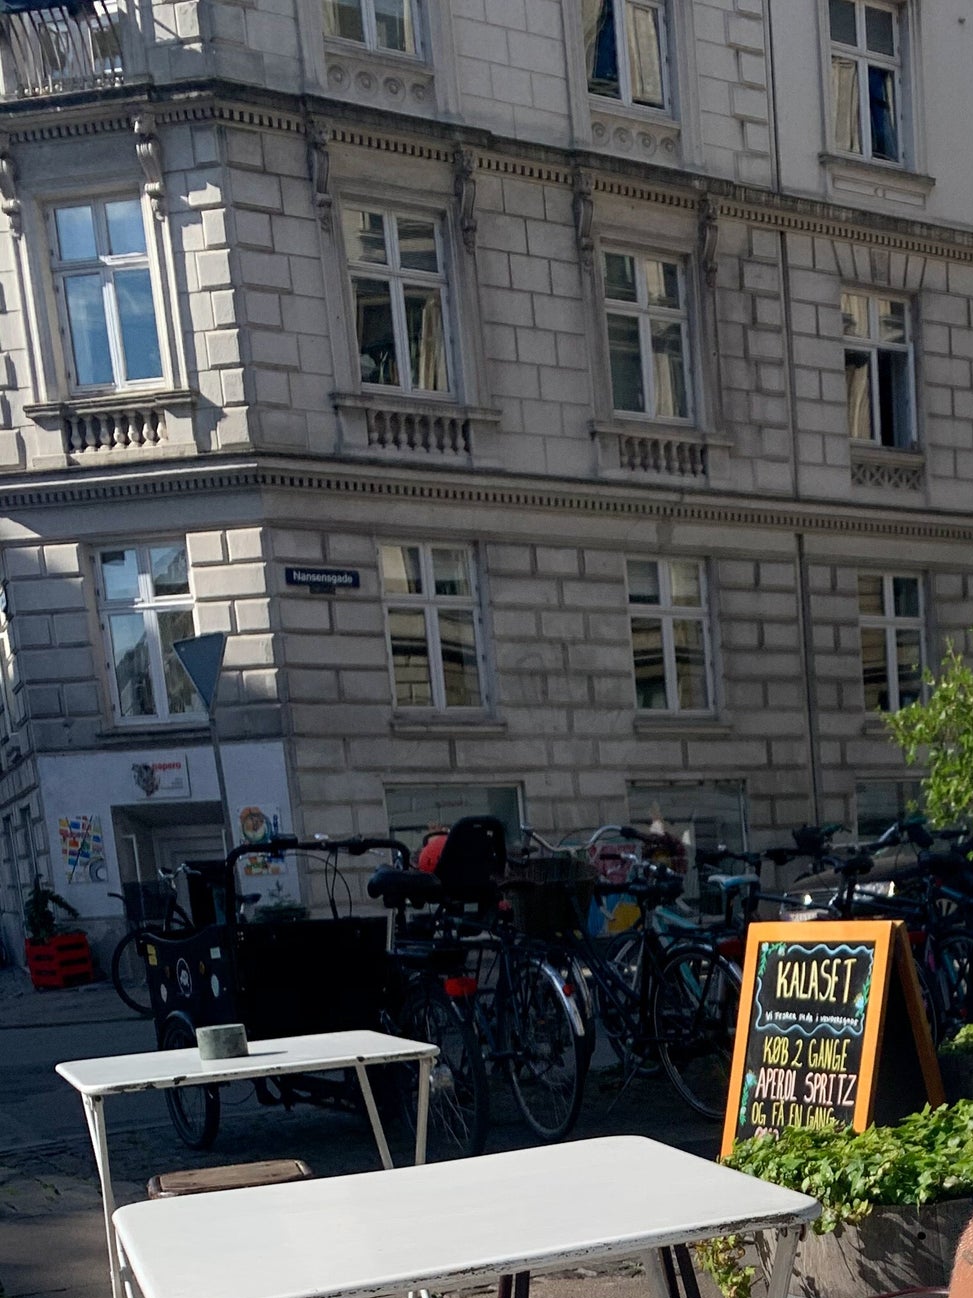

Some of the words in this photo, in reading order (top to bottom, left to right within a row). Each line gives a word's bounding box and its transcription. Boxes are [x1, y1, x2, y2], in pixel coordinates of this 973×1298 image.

[292, 570, 353, 584] Nansensgade
[775, 958, 858, 1004] KALASET
[763, 1035, 789, 1067] KØB
[791, 1038, 803, 1068] 2
[808, 1038, 851, 1072] GANGE
[754, 1066, 798, 1101] APEROL
[803, 1071, 858, 1106] SPRITZ
[751, 1101, 767, 1126] OG
[771, 1098, 785, 1126] FÅ
[788, 1102, 803, 1128] EN
